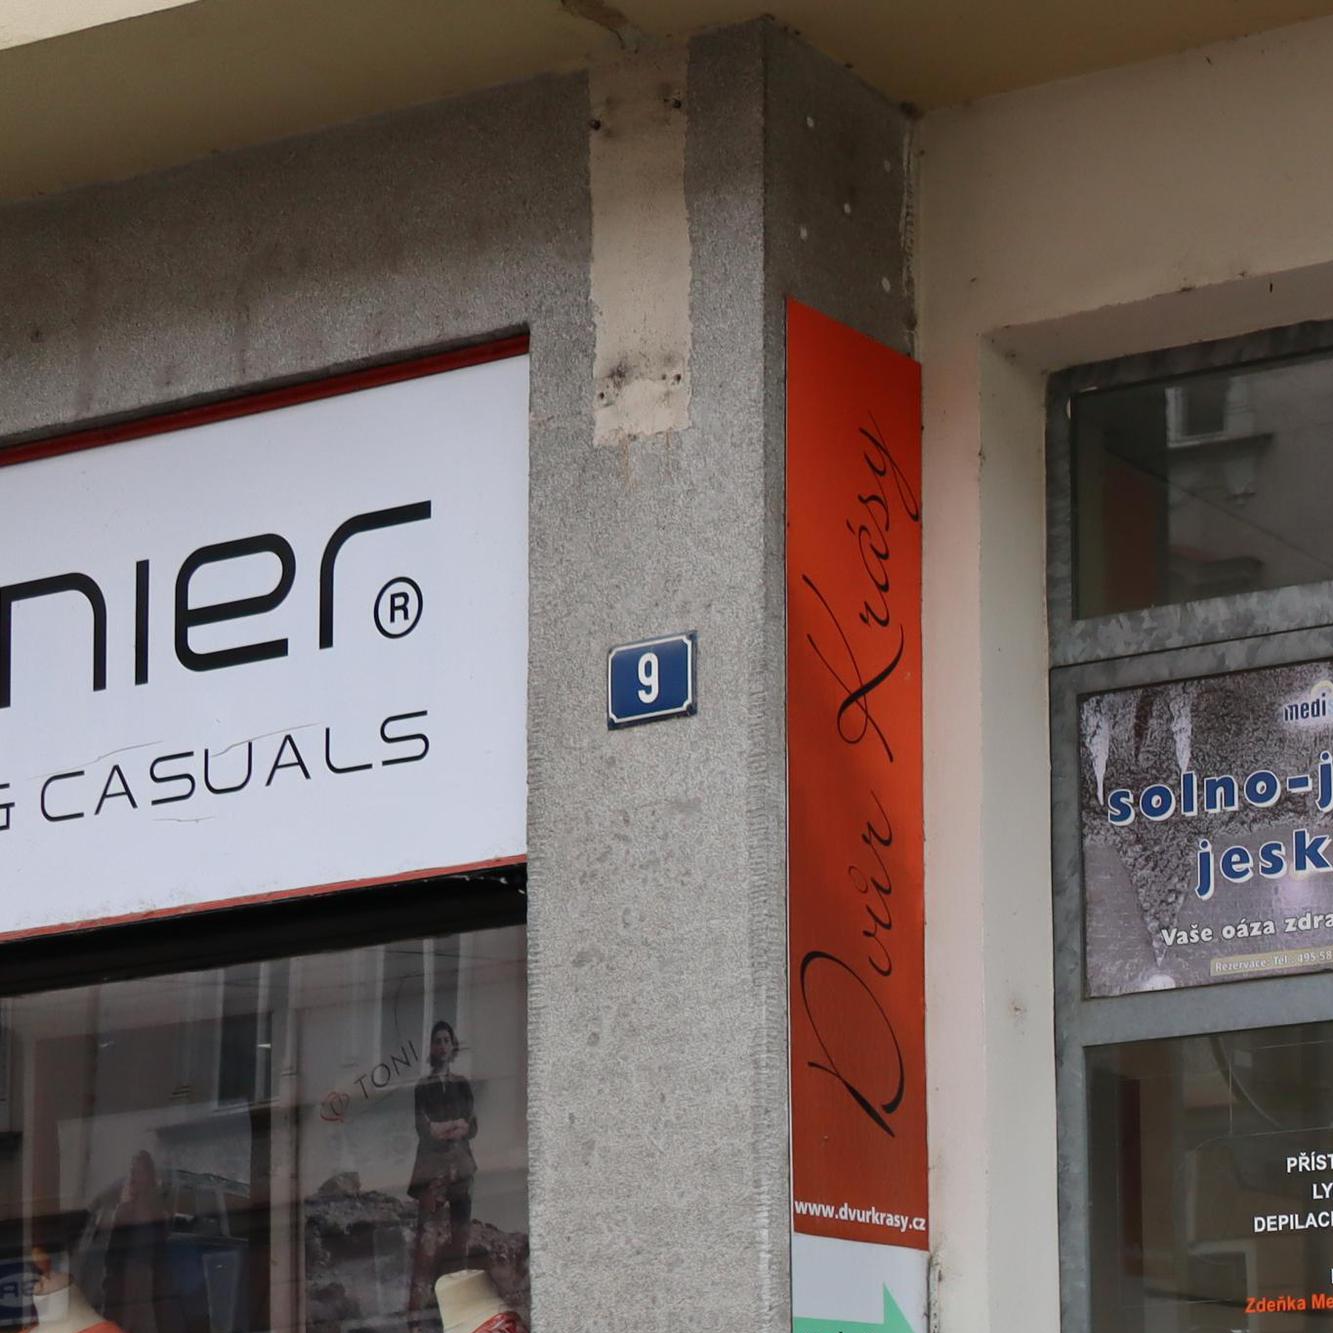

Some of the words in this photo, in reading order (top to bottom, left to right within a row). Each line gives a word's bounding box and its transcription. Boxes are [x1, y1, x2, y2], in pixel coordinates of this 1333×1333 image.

[802, 410, 921, 763] Krásy
[637, 651, 660, 704] 9
[40, 710, 430, 822] CASUALS
[1160, 920, 1213, 947] Vaše
[1221, 914, 1277, 941] oáza
[800, 789, 905, 1138] Dvůr
[353, 1040, 419, 1099] TONI
[794, 1199, 926, 1232] www.dvurkrasy.cz
[1245, 1293, 1307, 1314] Zdeňka
